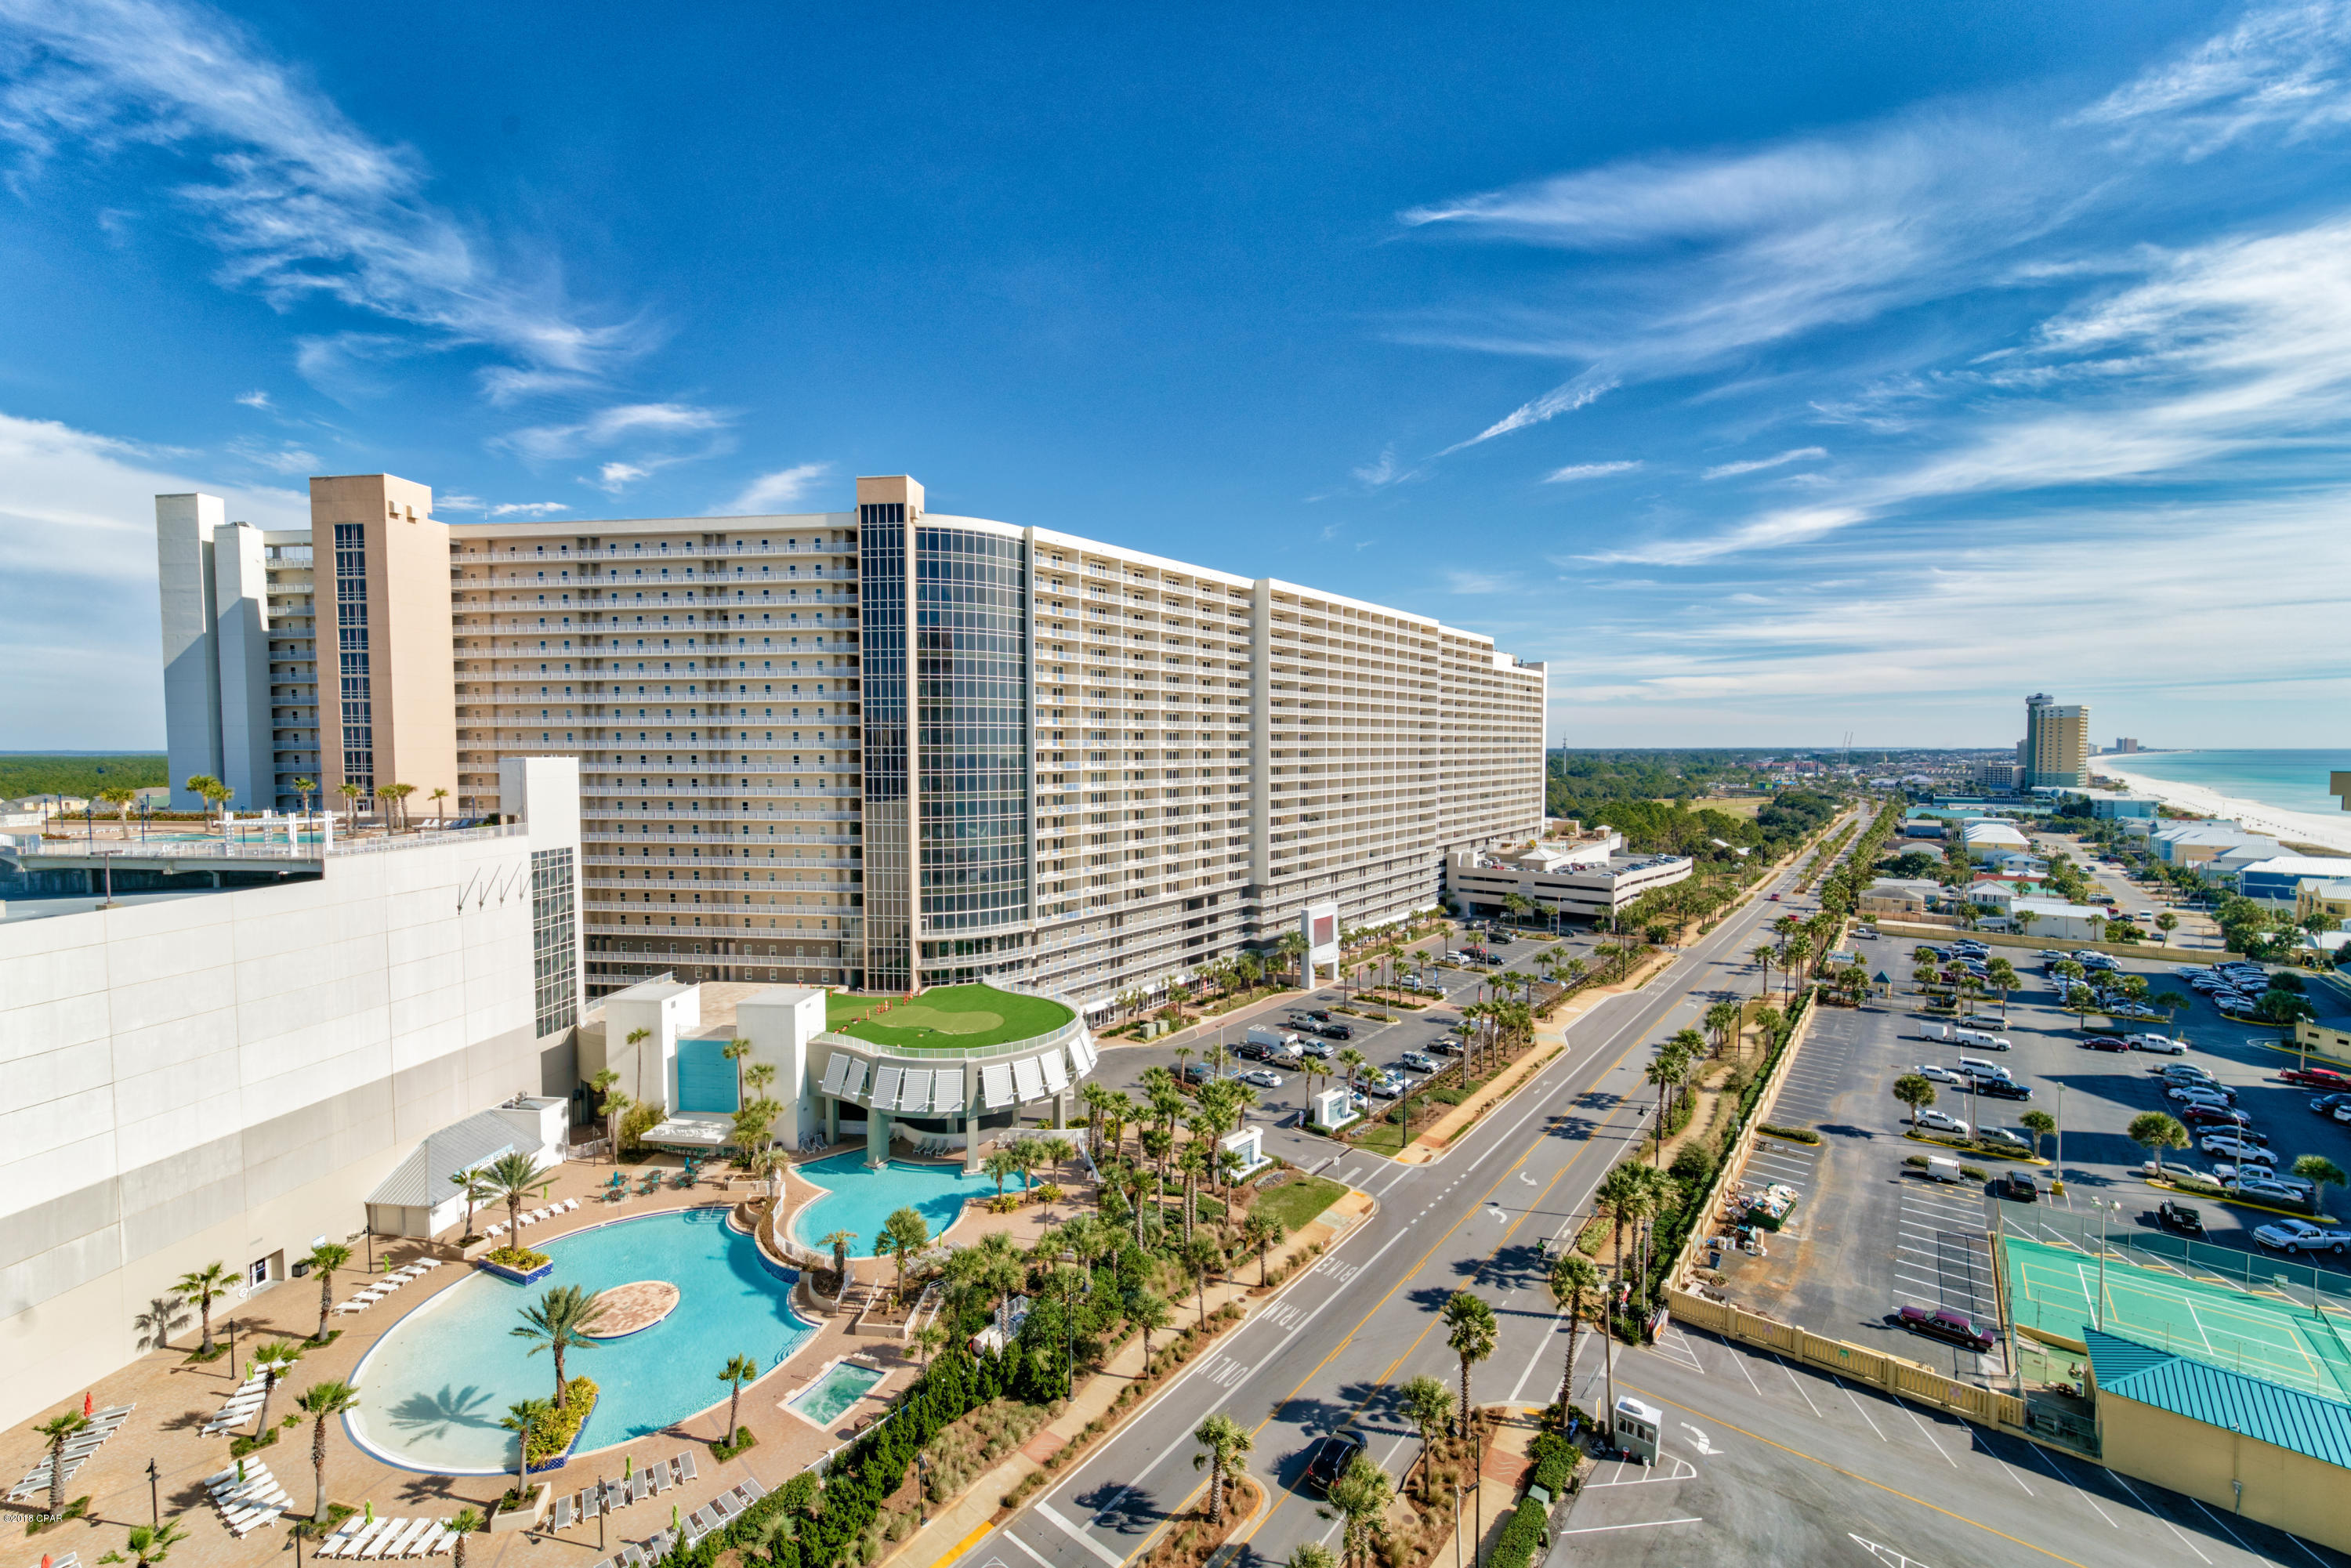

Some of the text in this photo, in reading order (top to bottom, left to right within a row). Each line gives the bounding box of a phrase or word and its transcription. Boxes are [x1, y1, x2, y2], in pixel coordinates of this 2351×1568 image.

[1314, 1257, 1359, 1283] BIKE
[1262, 1300, 1308, 1331] TRAM
[1197, 1353, 1248, 1387] ONLY
